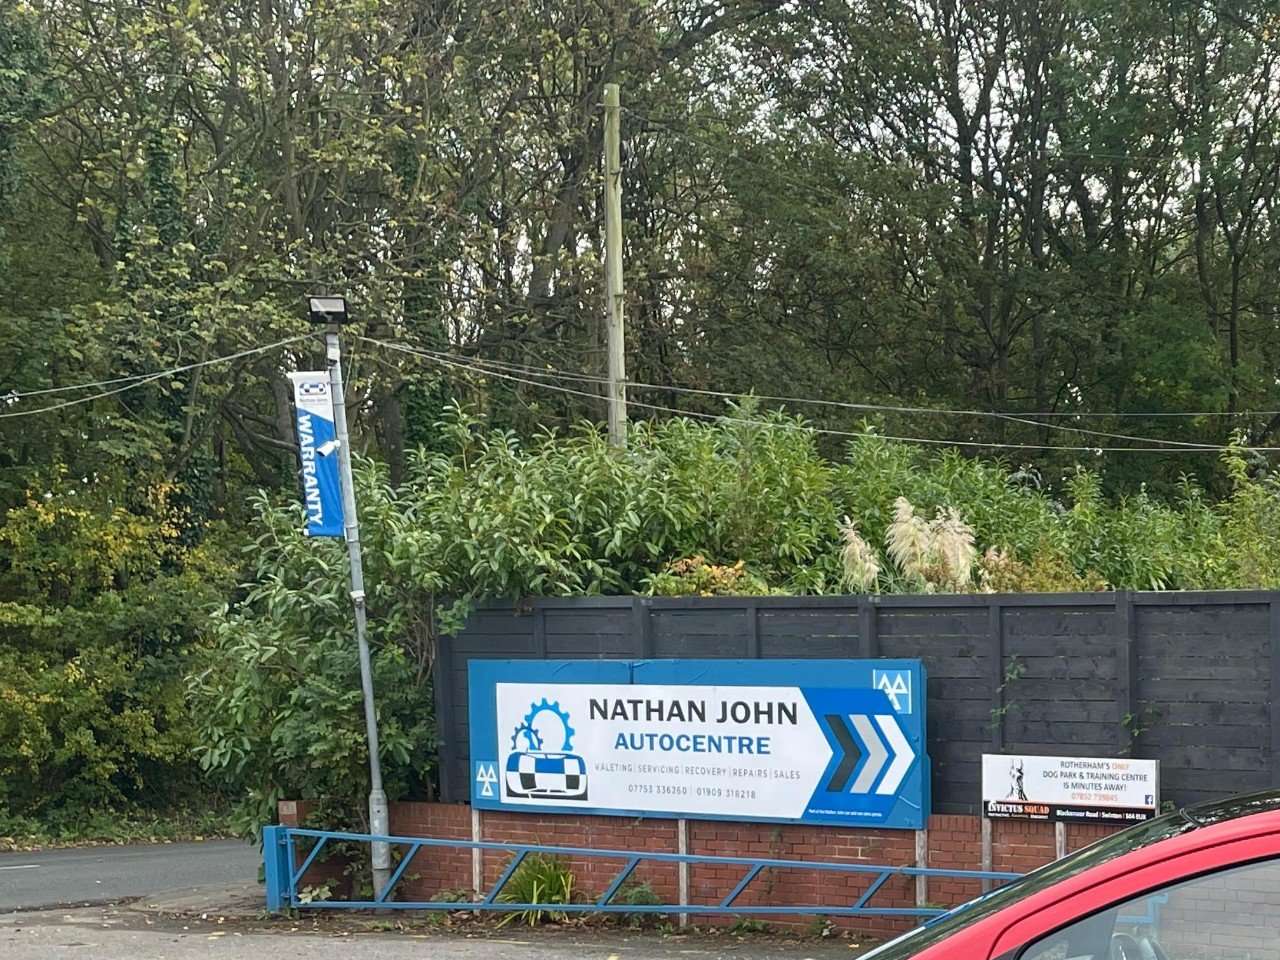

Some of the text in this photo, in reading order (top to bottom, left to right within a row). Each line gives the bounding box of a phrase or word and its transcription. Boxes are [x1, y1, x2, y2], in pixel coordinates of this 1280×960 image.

[297, 414, 323, 525] WARRANTY
[589, 698, 798, 725] NATHAN JOHN
[614, 732, 771, 755] AUTOCENTRE
[595, 763, 800, 780] VALETING SERVICING RECOVERY REPAIRS SALES
[1060, 761, 1110, 770] ROTHERHAM'S
[1042, 770, 1058, 778] DOG
[1060, 771, 1077, 779] PARK
[1086, 772, 1120, 781] TRAINING
[1121, 773, 1148, 782] CENTRE
[1071, 782, 1102, 791] MINUTES
[1103, 783, 1126, 792] AWAY!
[1023, 805, 1050, 814] SQUAD
